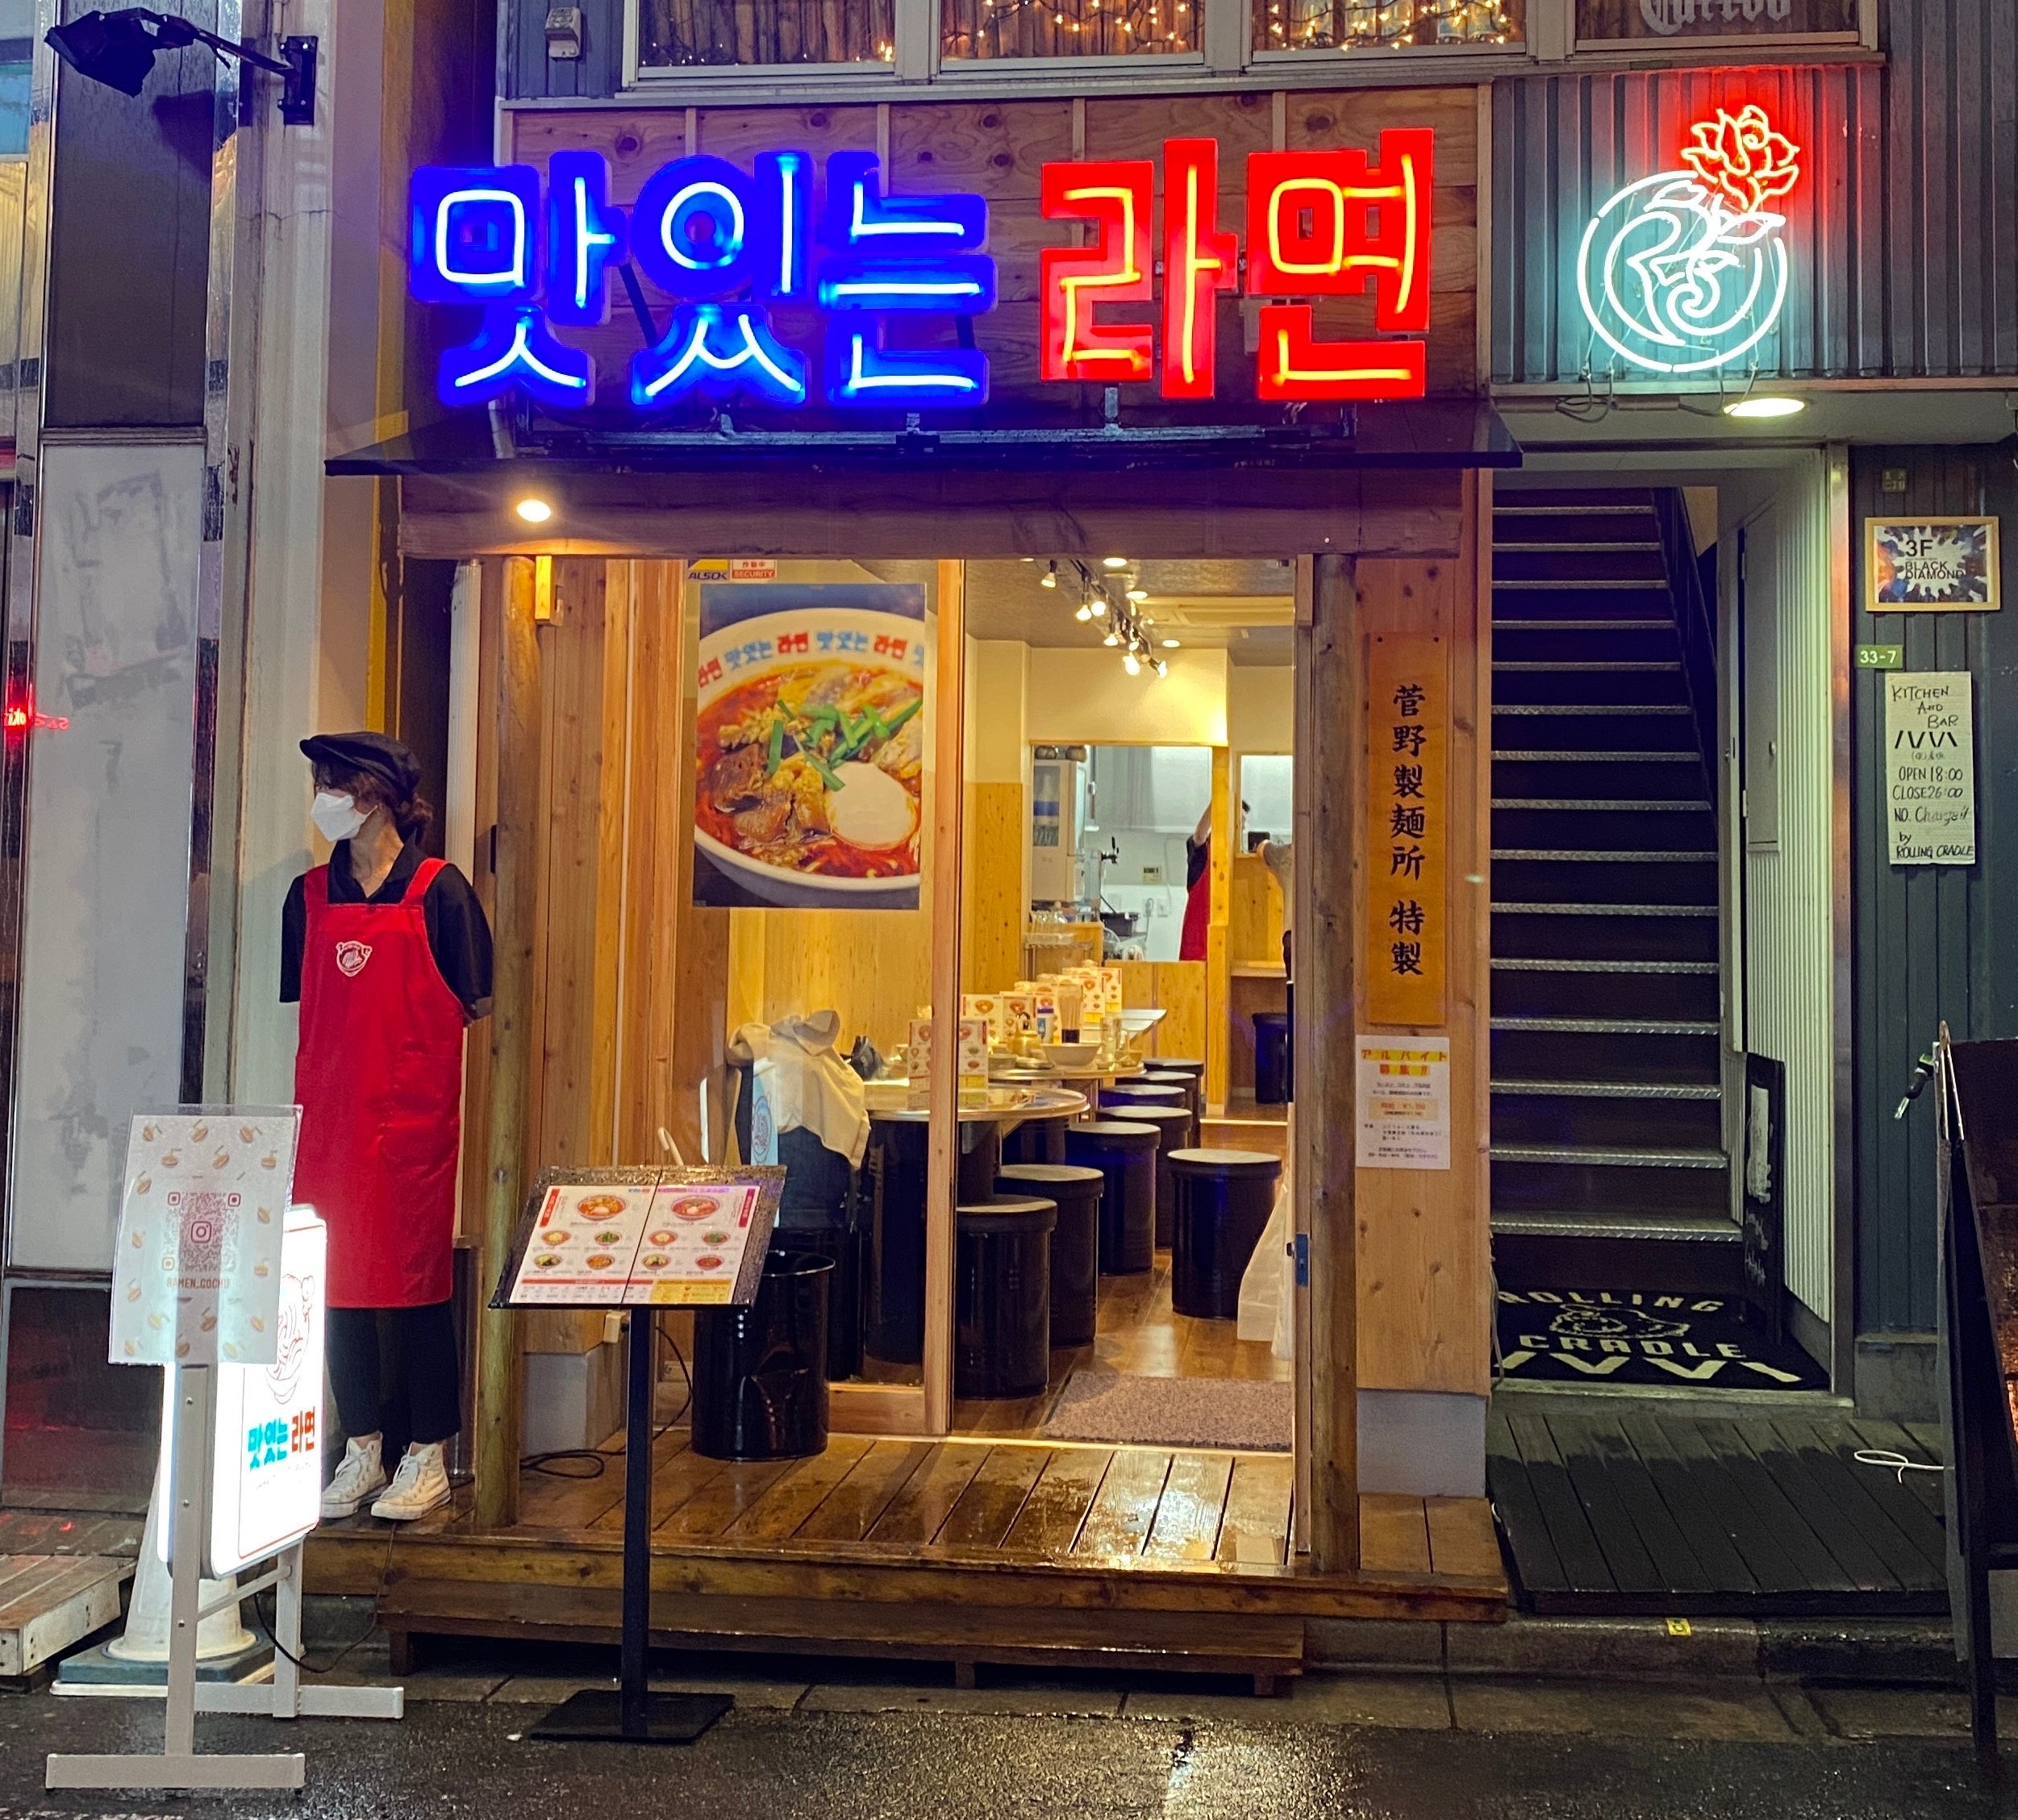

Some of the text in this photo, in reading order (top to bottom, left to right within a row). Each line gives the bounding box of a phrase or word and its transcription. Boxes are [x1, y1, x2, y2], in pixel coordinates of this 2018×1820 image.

[411, 128, 1433, 405] 맛있는 라면
[1905, 539, 1933, 556] 3F
[1905, 561, 1948, 571] BLACK
[688, 572, 728, 580] ALSOK
[733, 570, 774, 578] SECURITY
[1905, 569, 1965, 579] DIAMOND
[1860, 650, 1897, 664] 33-7
[1891, 685, 1949, 702] KITCHEN
[1928, 714, 1959, 729] BAR
[1899, 766, 1963, 782] OPEN 18:00
[1899, 831, 1912, 846] by
[1897, 844, 1974, 859] ROLLING CRADLE
[1389, 899, 1426, 977] 特製
[1498, 1290, 1724, 1312] ROLLING
[1519, 1335, 1747, 1359] CRADLE
[248, 1406, 315, 1473] 맛있는 라면
